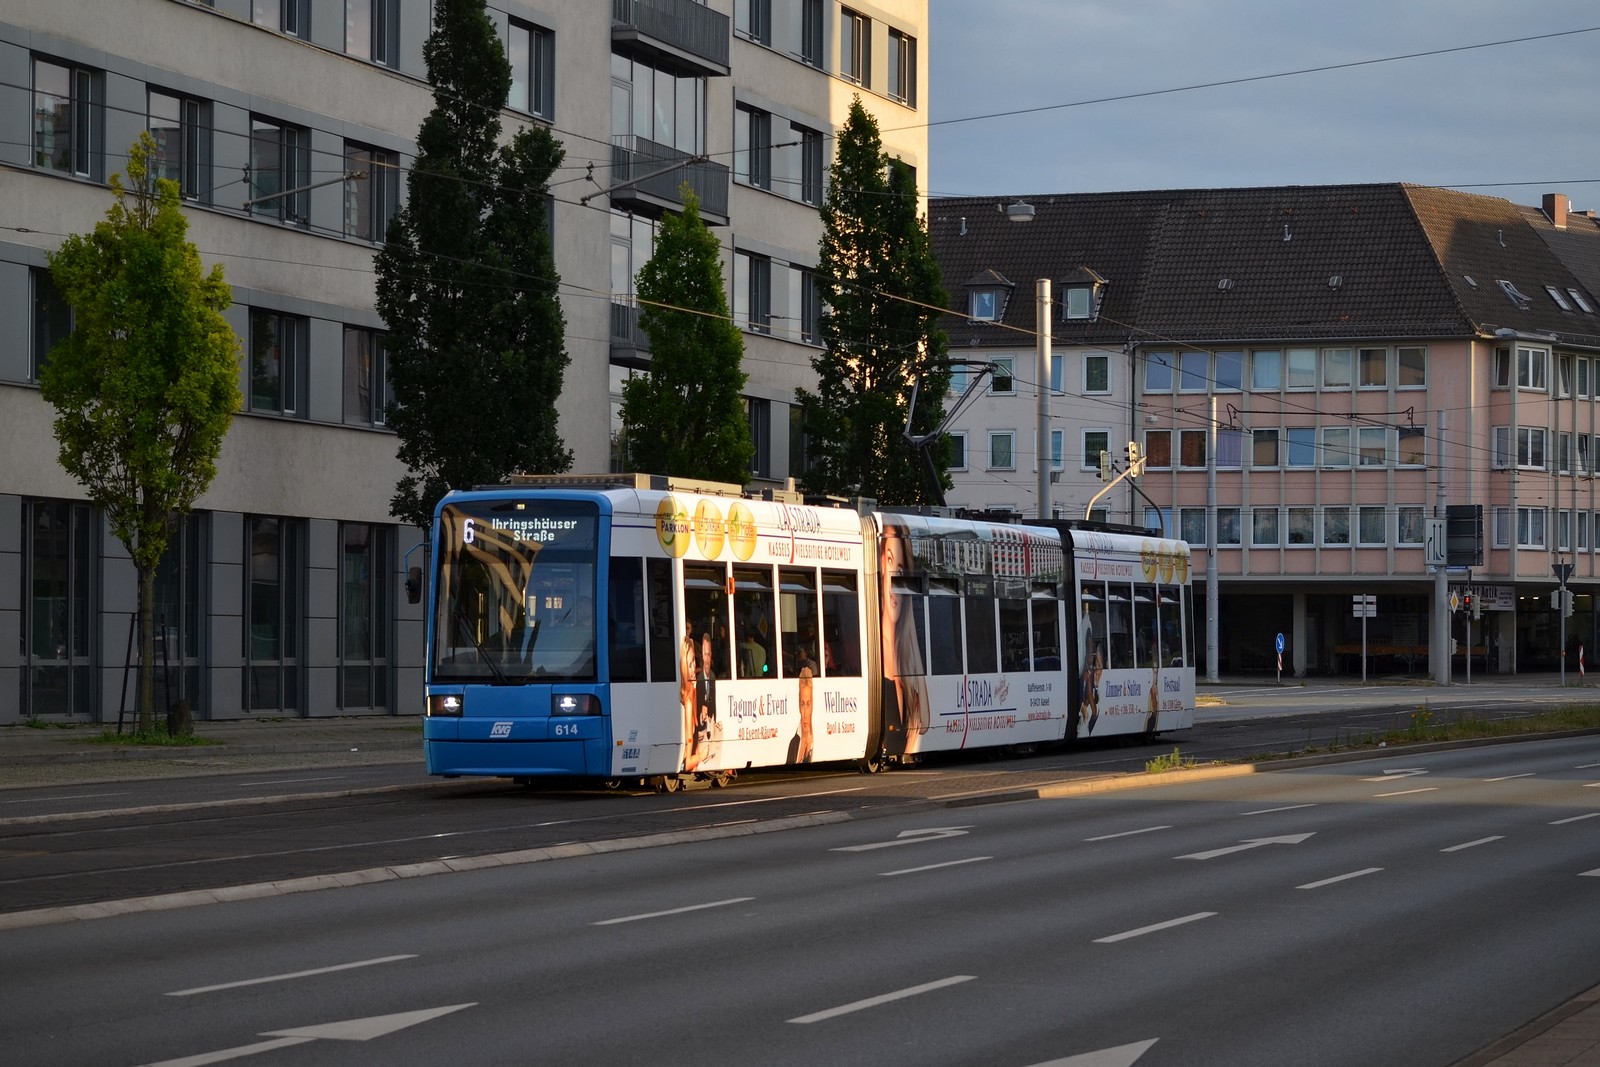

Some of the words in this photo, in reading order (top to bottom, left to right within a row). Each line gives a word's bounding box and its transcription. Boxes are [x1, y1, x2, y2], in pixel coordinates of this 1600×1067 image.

[492, 518, 577, 531] Ihringshäuser
[789, 506, 823, 534] STRADA
[463, 518, 475, 544] 6
[513, 530, 555, 542] Straße
[768, 542, 790, 557] KASSELS
[825, 545, 851, 561] HOTELWELT
[823, 691, 858, 714] Wellness
[957, 681, 965, 708] LA
[967, 680, 993, 707] STRADA
[728, 695, 758, 723] Tagung
[759, 695, 765, 716] &
[766, 693, 788, 716] Event
[555, 724, 579, 736] 614
[841, 721, 856, 734] Sauna
